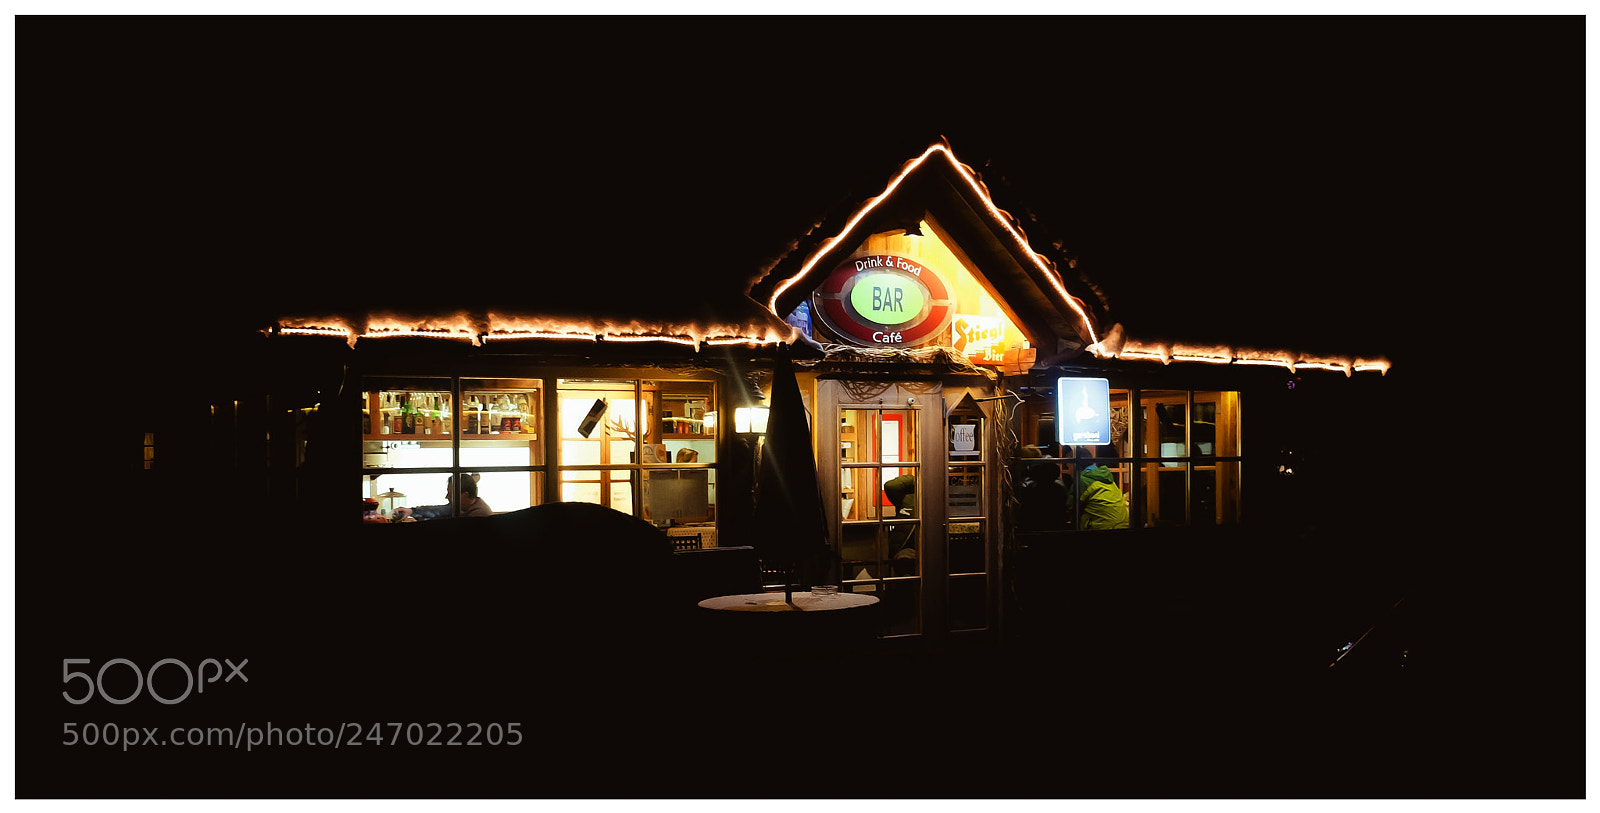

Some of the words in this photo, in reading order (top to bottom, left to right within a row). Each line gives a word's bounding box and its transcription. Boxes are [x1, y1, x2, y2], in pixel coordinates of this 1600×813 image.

[855, 256, 883, 272] Drink
[885, 255, 894, 267] &
[896, 257, 922, 277] Food
[872, 286, 904, 312] BAR
[872, 331, 903, 344] Café
[953, 318, 1002, 353] Stiegl
[983, 348, 1004, 362] Bier
